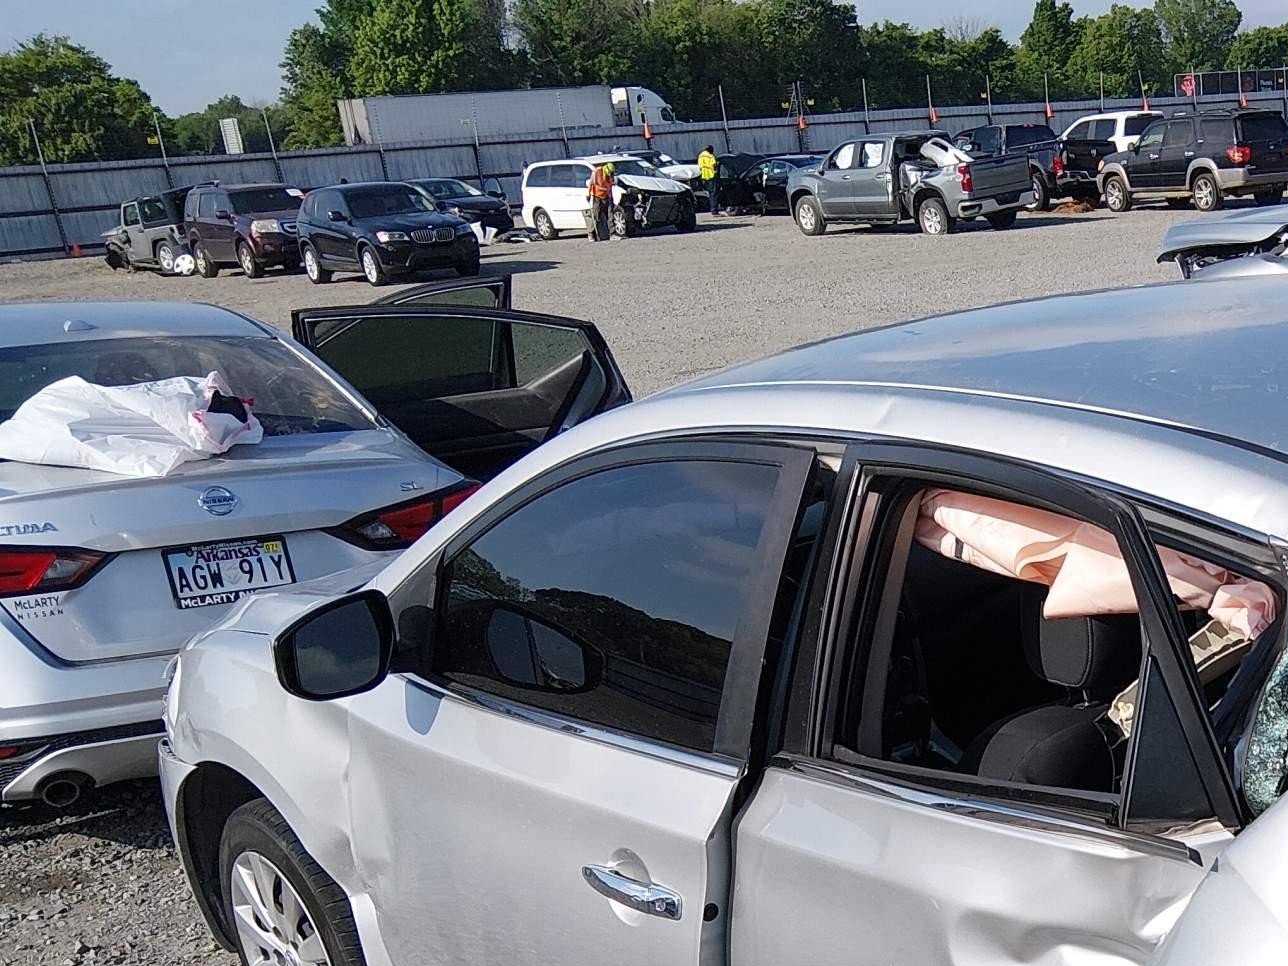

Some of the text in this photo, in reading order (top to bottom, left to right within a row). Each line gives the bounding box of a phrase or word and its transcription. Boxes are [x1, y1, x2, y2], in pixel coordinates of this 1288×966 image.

[202, 496, 234, 504] NISSAN
[195, 545, 260, 564] Arkansas
[177, 554, 284, 594] AGW 91Y
[14, 596, 60, 610] McLARTY
[181, 592, 236, 609] McLARTY
[17, 609, 64, 619] NISSAN
